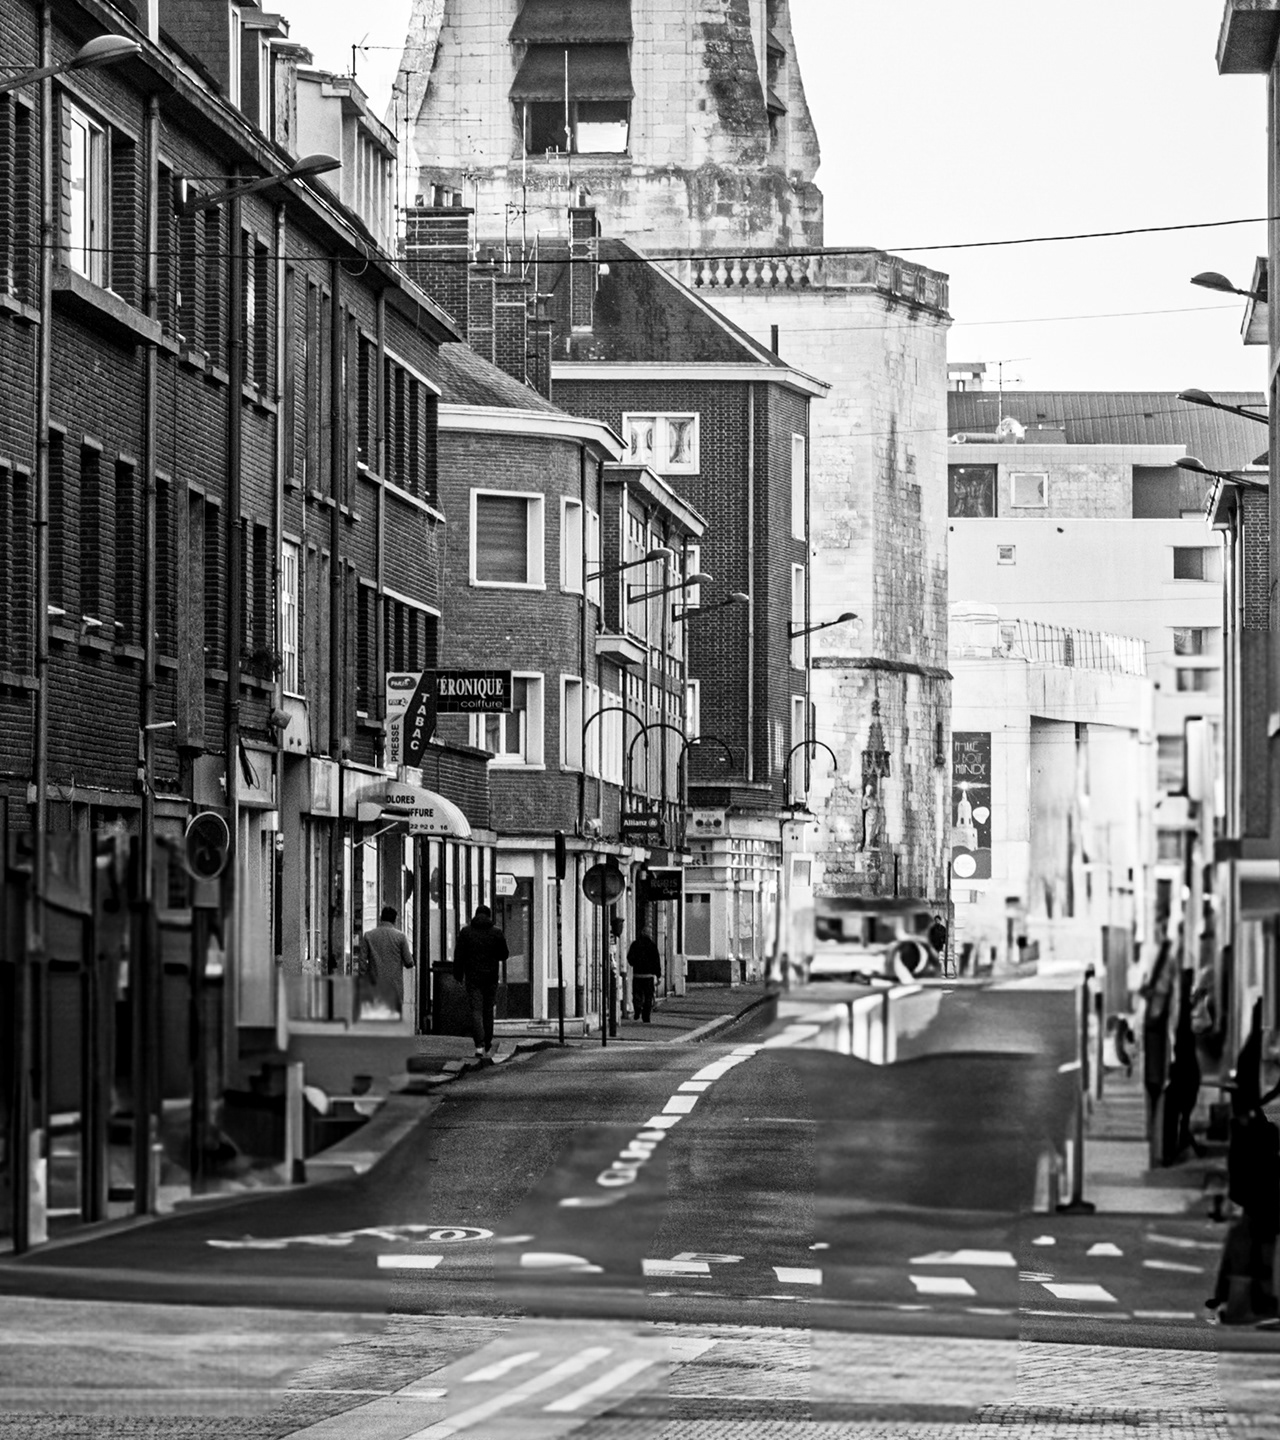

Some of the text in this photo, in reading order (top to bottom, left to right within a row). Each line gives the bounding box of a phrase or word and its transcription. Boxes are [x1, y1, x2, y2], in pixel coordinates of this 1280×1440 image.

[437, 675, 504, 699] ÉRONIQUE
[460, 700, 503, 708] coiffure
[410, 693, 430, 751] TABAC
[391, 723, 400, 762] PRESSE
[386, 795, 415, 804] OLORES
[409, 808, 434, 818] FFURE
[623, 819, 648, 827] Allianz
